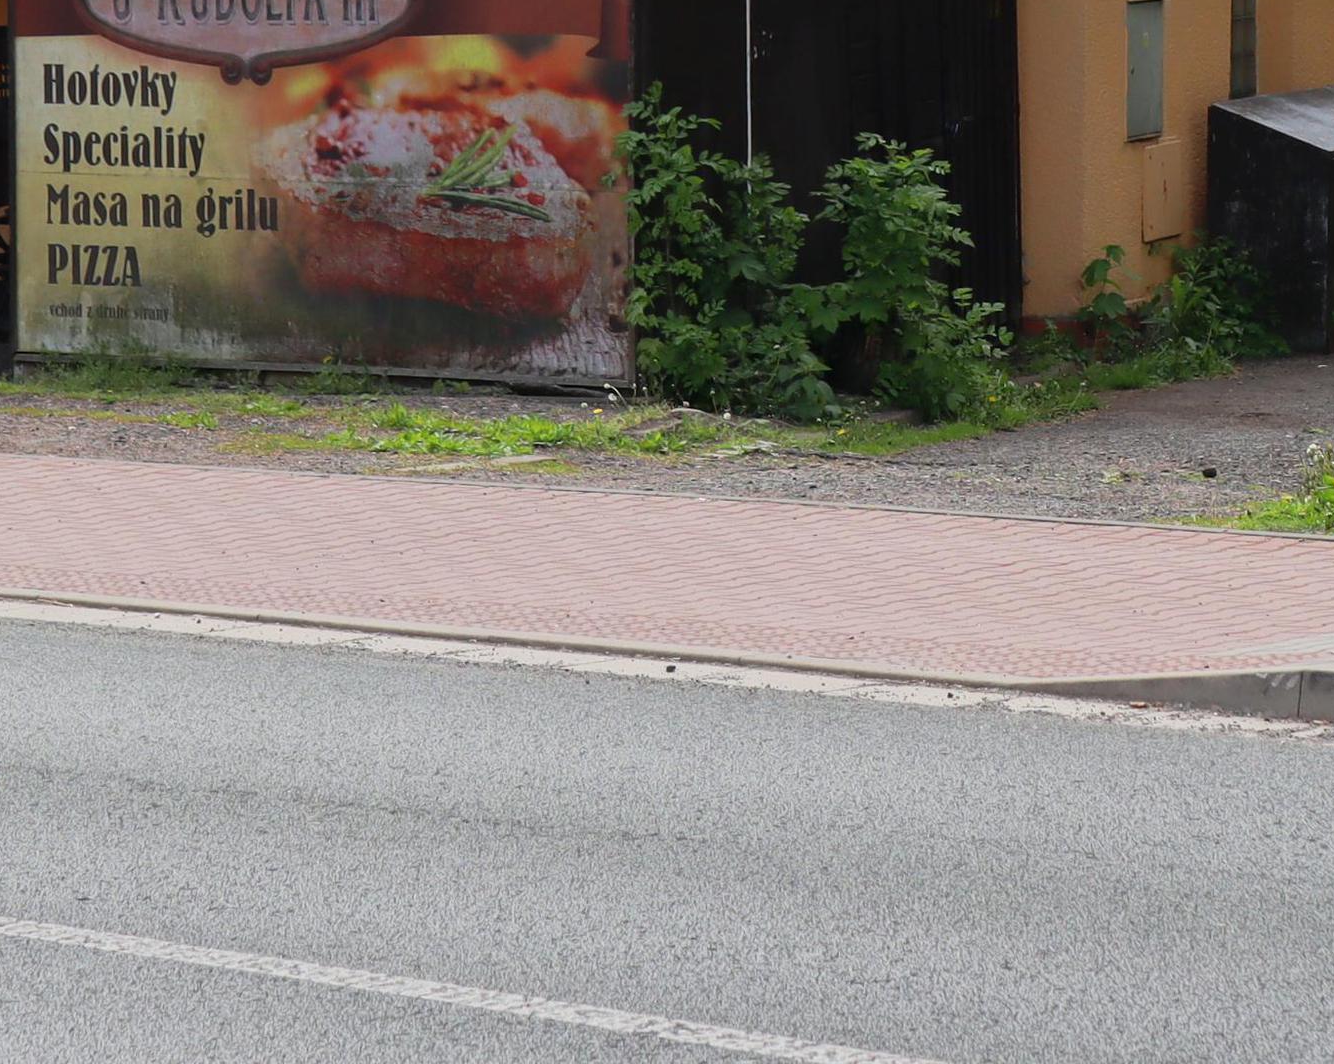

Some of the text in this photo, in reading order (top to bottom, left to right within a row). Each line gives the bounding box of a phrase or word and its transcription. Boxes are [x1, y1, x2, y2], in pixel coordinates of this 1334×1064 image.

[43, 63, 177, 116] Hotovky
[43, 124, 206, 177] Speciality
[46, 184, 279, 237] Masa na grilu
[47, 244, 142, 287] PIZZA
